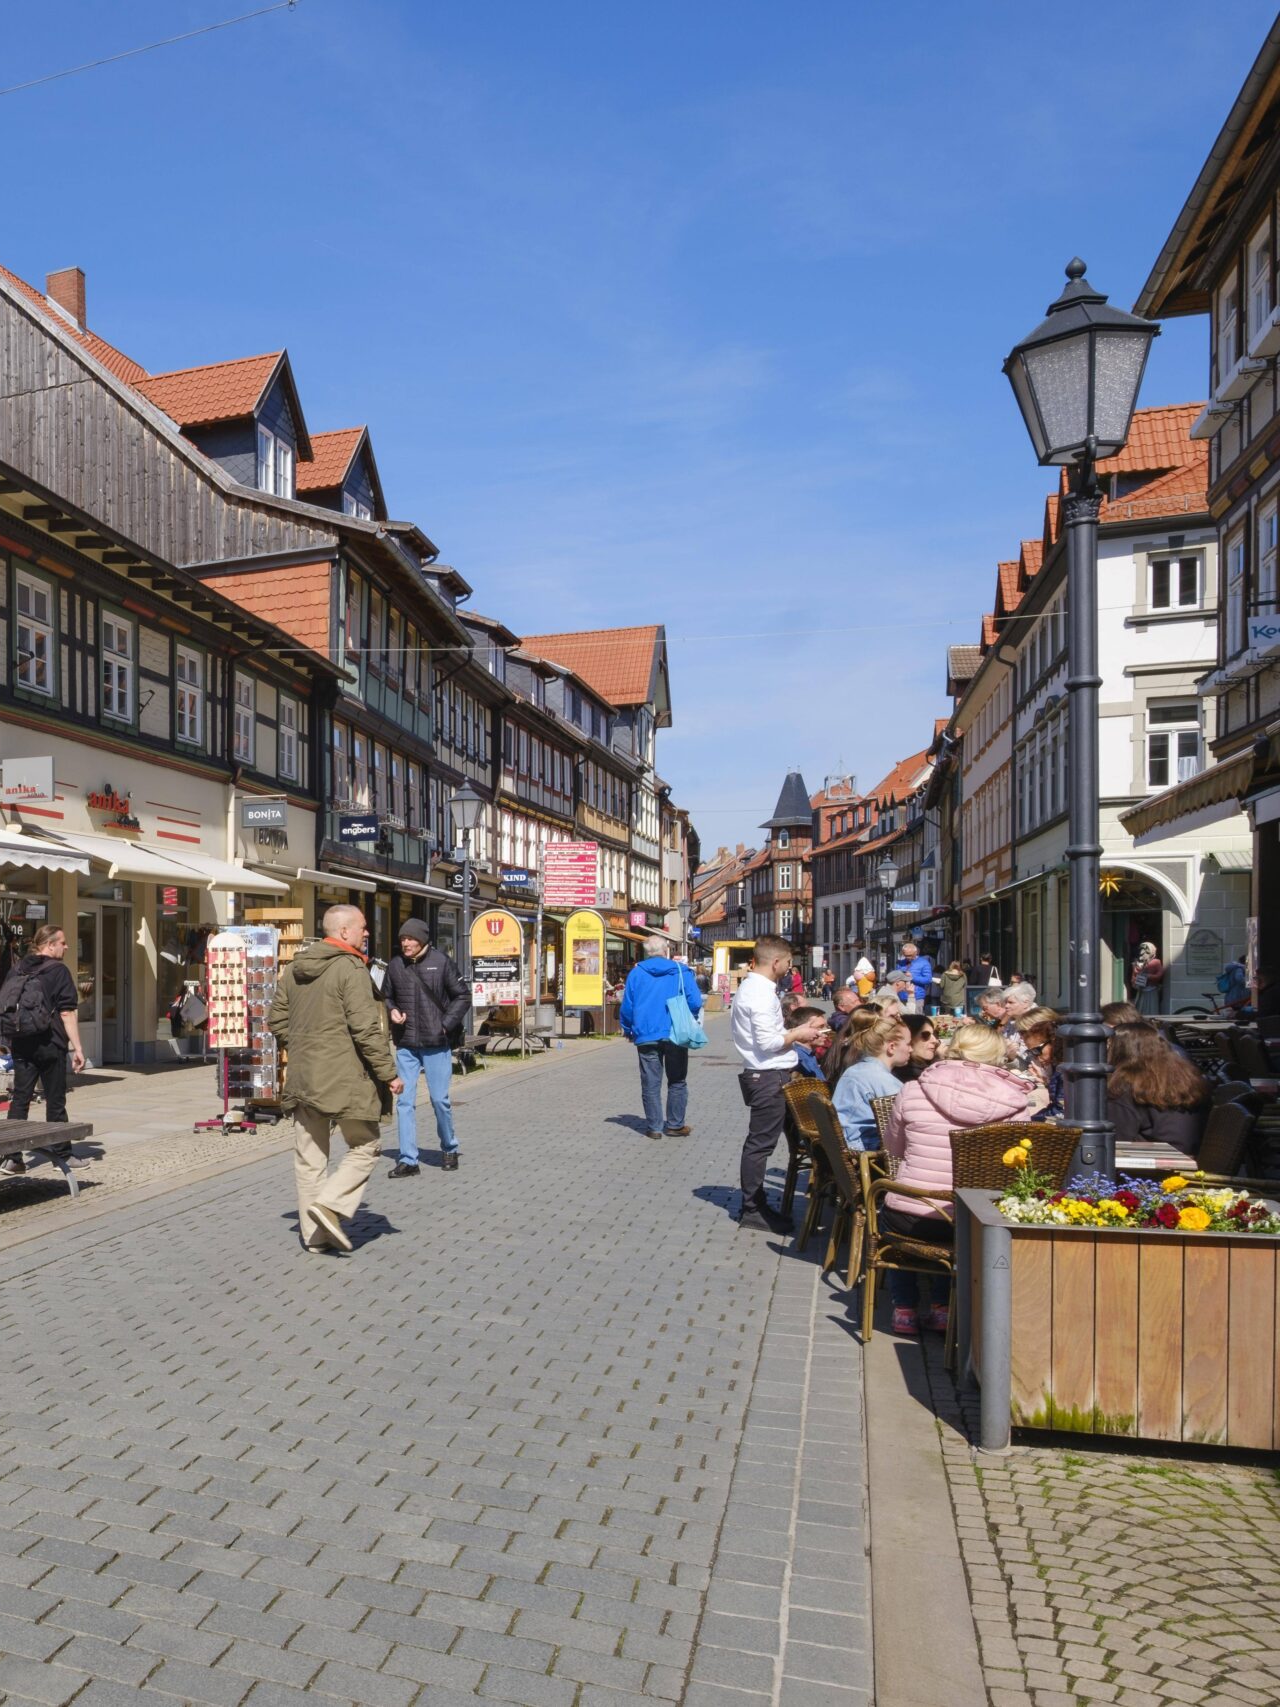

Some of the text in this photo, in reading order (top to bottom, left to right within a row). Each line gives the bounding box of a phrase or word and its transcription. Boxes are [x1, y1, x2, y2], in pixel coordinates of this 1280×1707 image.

[6, 784, 36, 795] anika
[88, 786, 130, 814] anika
[248, 809, 282, 820] BONITA
[342, 826, 376, 836] engbers
[503, 874, 527, 882] KIND
